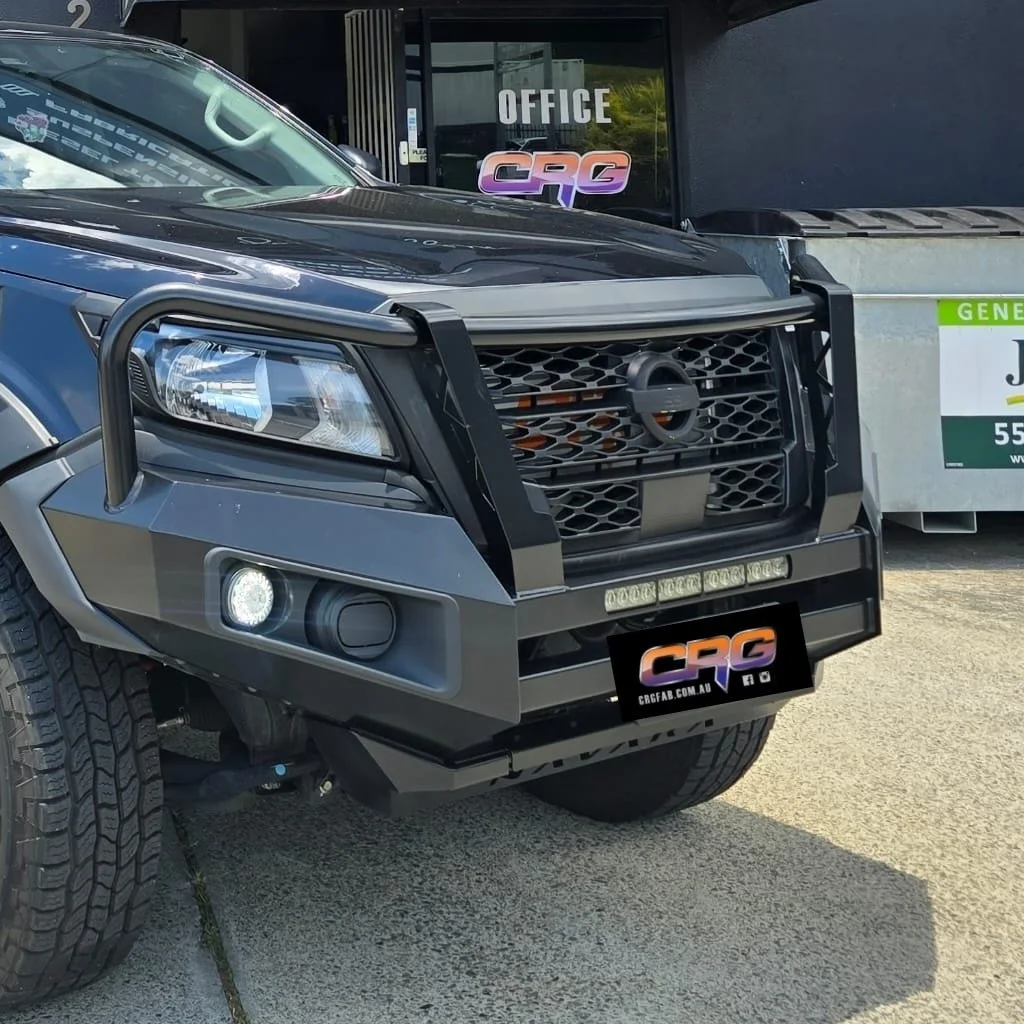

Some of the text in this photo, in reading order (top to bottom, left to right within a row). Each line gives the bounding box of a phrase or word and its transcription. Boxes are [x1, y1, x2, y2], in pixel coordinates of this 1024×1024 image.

[498, 88, 612, 125] OFFICE
[478, 150, 632, 208] CRG
[994, 422, 1024, 445] 55
